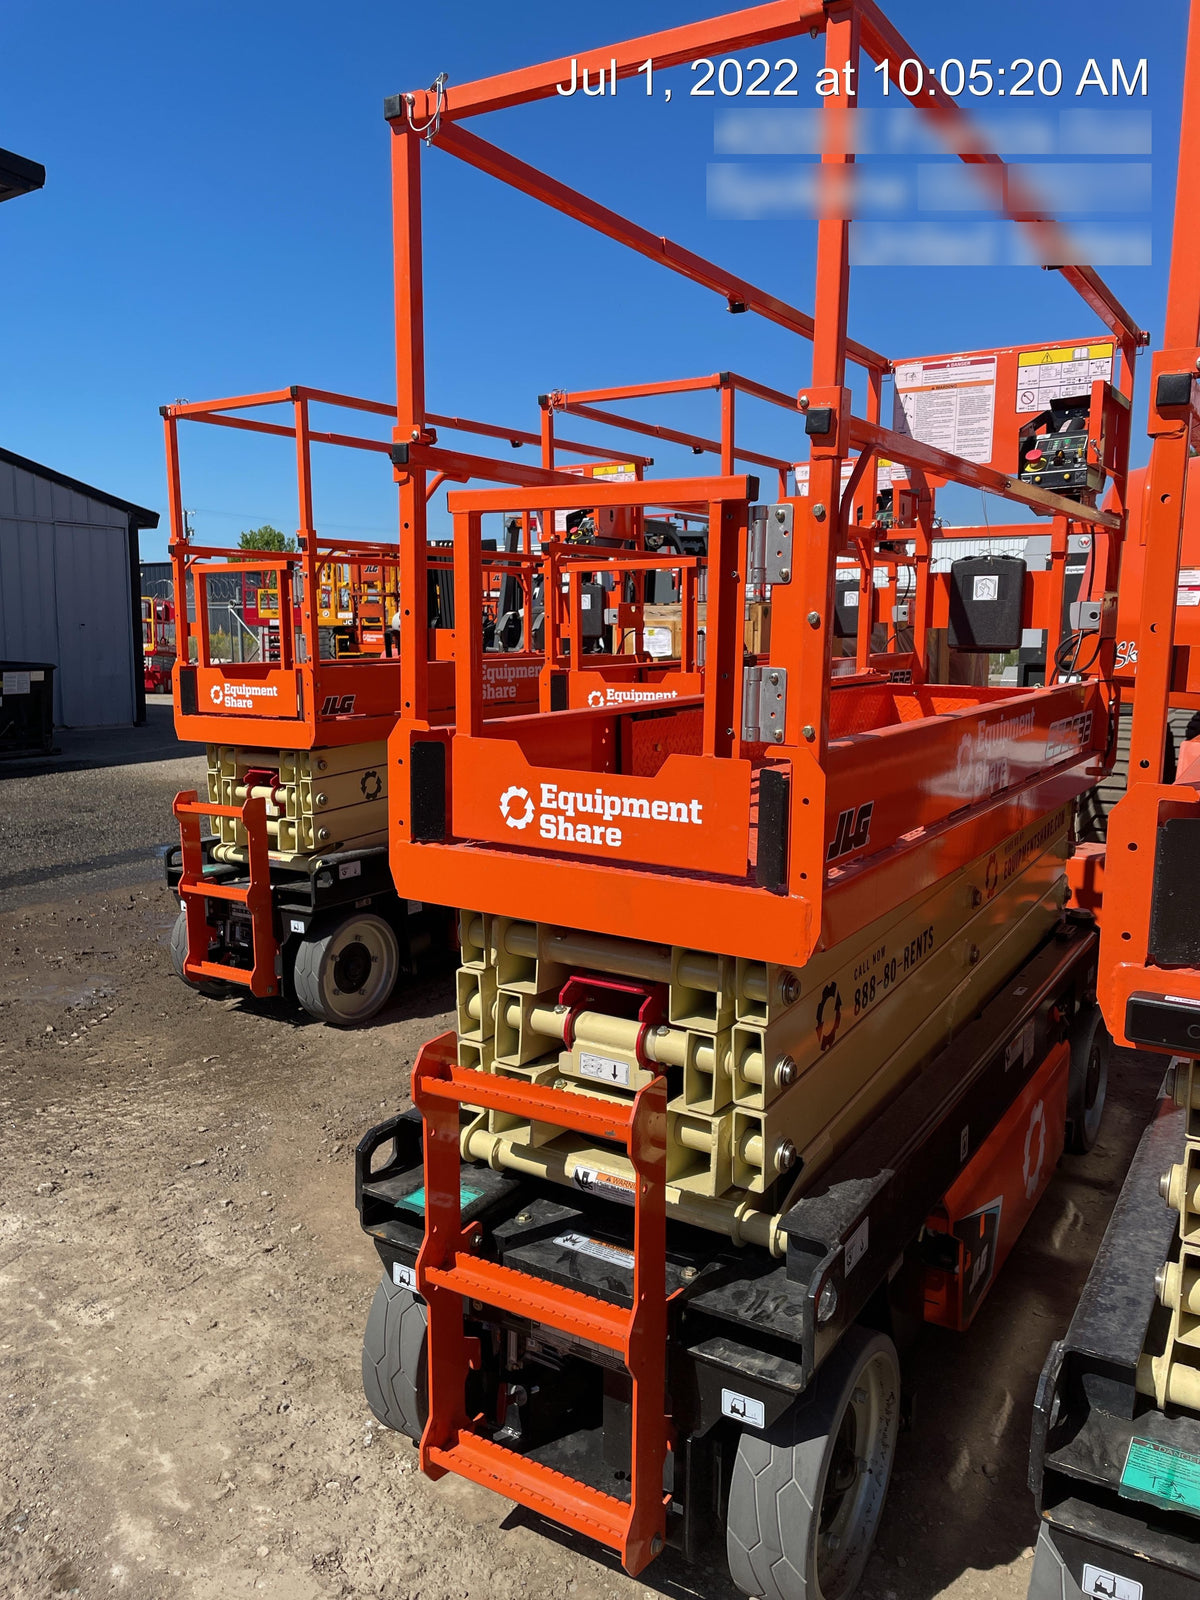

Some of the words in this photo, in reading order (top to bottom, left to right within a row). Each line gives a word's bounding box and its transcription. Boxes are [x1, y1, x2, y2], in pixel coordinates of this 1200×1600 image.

[364, 565, 379, 573] JLG
[1114, 641, 1138, 669] Sk
[483, 664, 541, 684] quipmen
[224, 683, 278, 698] Equipment
[224, 696, 253, 708] Share
[321, 694, 356, 715] JLG
[977, 707, 1036, 757] Equipment
[540, 783, 703, 825] Equipment
[540, 813, 622, 847] Share
[826, 800, 875, 863] JLG
[854, 959, 870, 981] CALL
[873, 945, 886, 966] NOW
[854, 925, 934, 1017] 888-80-RENTS
